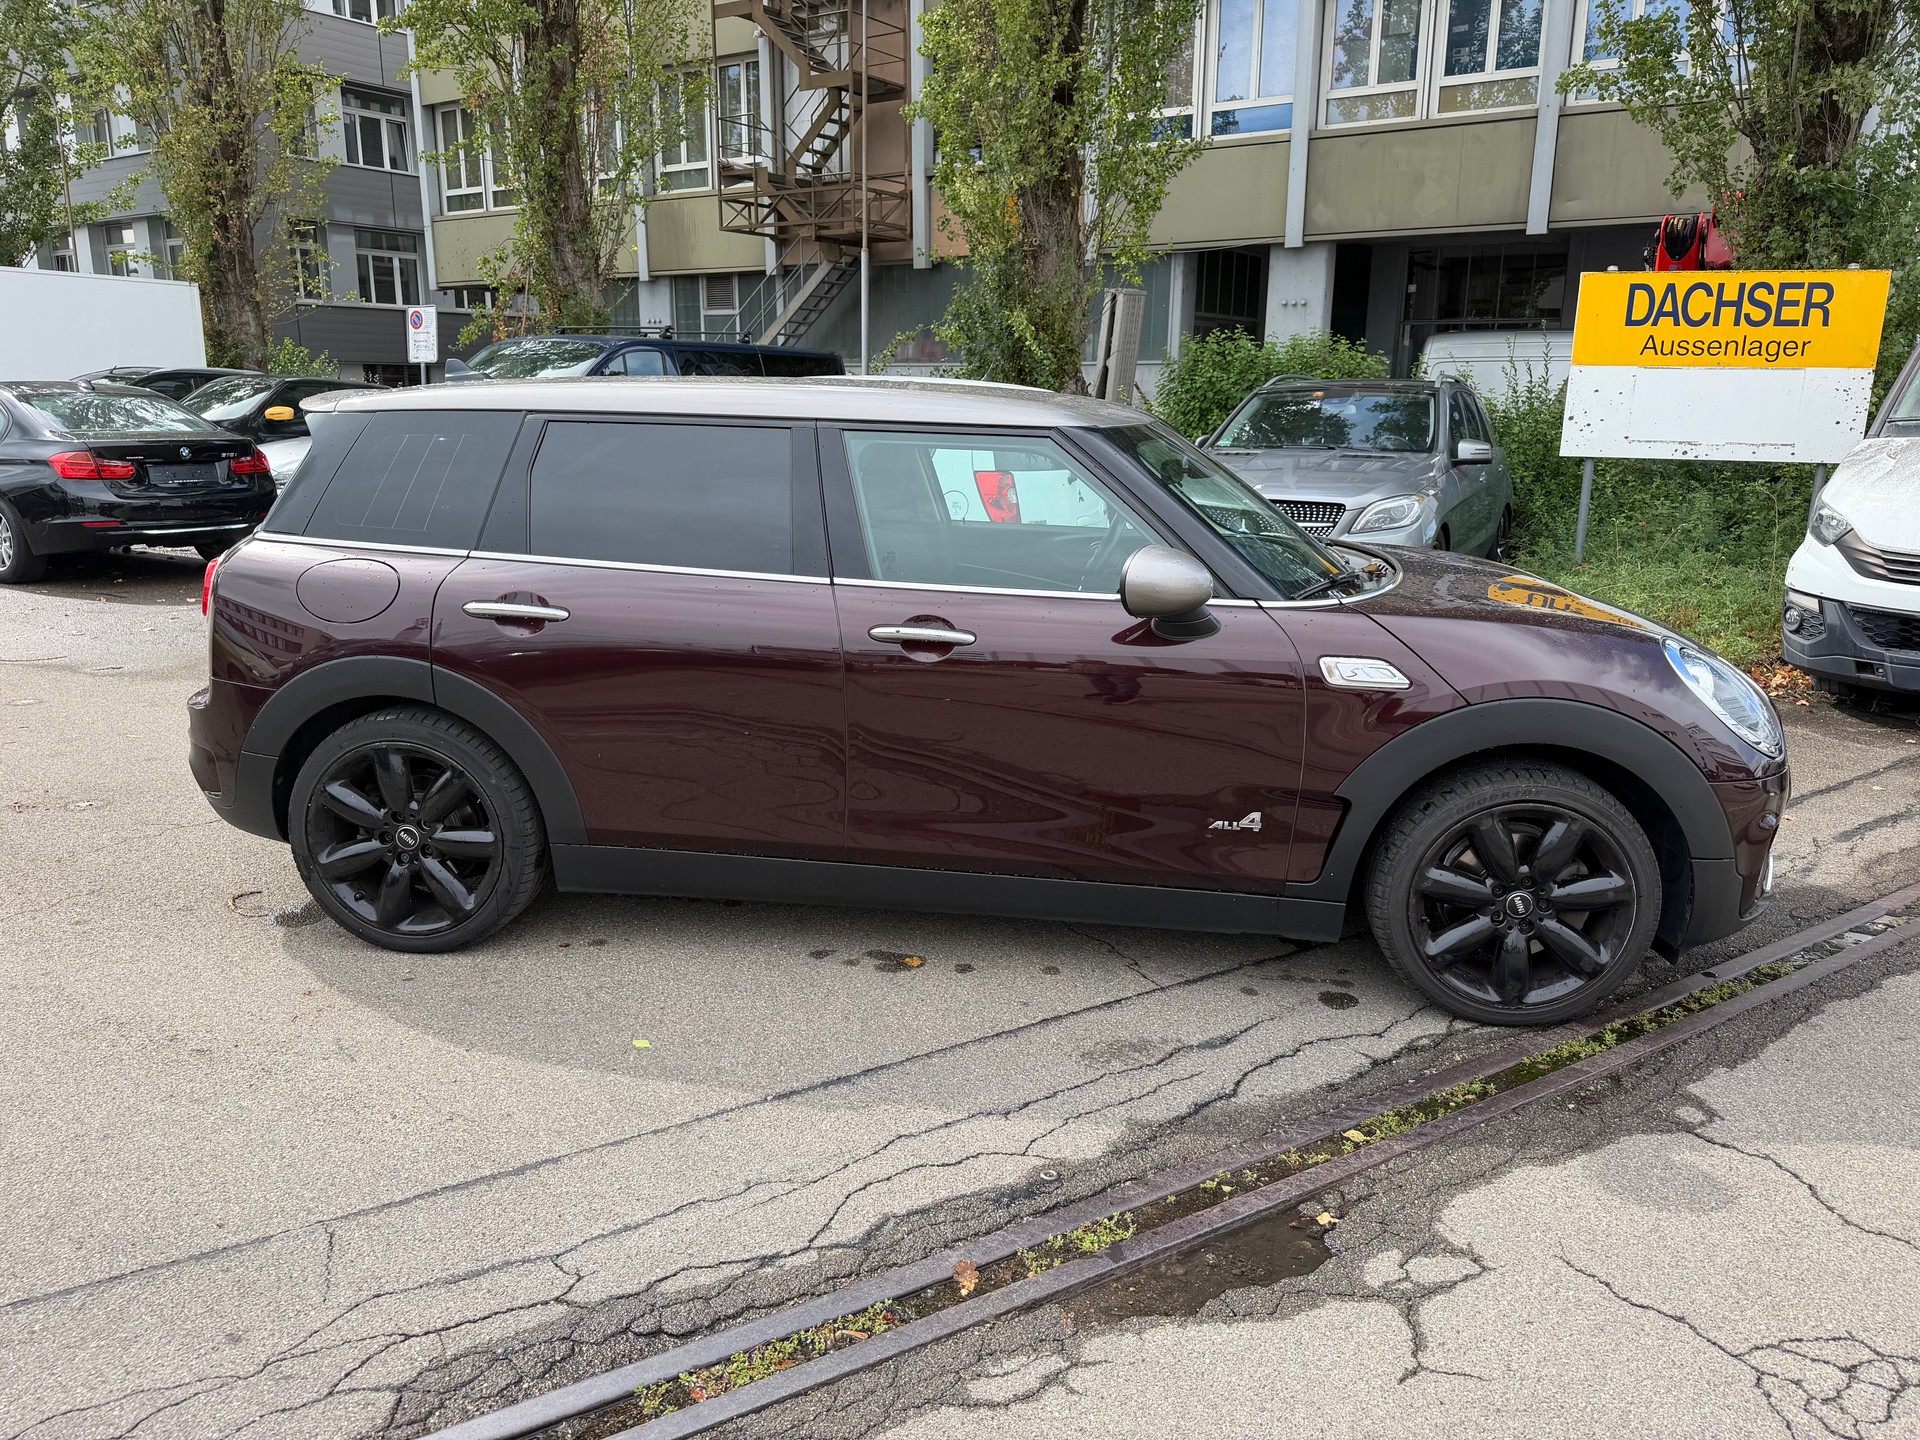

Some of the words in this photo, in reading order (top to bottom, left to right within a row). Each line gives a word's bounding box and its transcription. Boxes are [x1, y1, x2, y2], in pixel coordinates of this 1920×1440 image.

[1625, 282, 1835, 327] DACHSER
[1640, 334, 1811, 363] Aussenlager
[1208, 811, 1262, 832] ALL4
[399, 831, 416, 846] MINI
[1513, 896, 1526, 914] MINI
